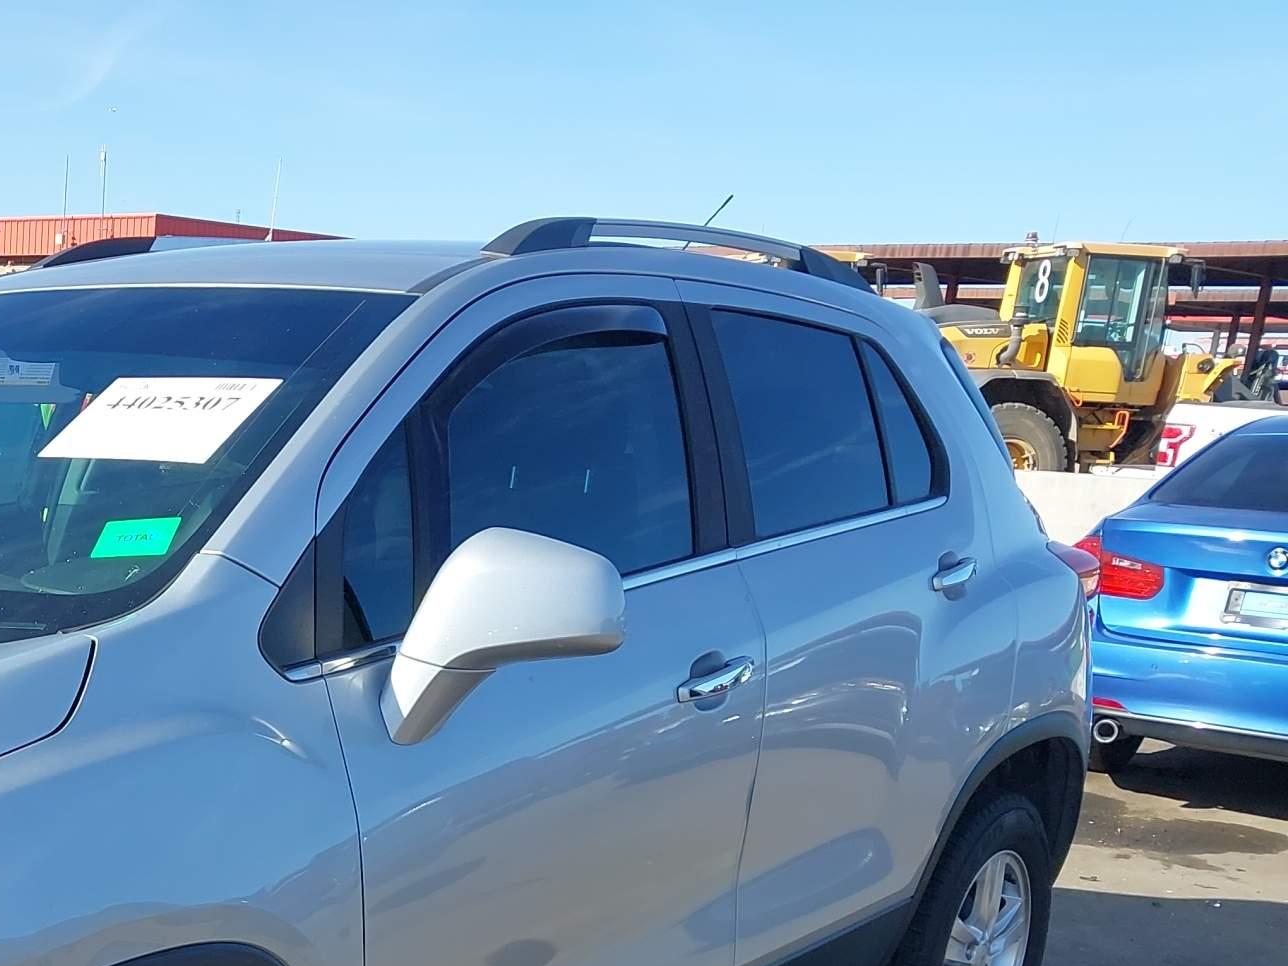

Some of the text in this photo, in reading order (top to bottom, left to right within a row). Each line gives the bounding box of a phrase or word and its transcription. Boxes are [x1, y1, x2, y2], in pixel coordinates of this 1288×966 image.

[1035, 259, 1051, 303] 8
[964, 327, 1003, 335] VOLV
[106, 396, 243, 411] 44025307
